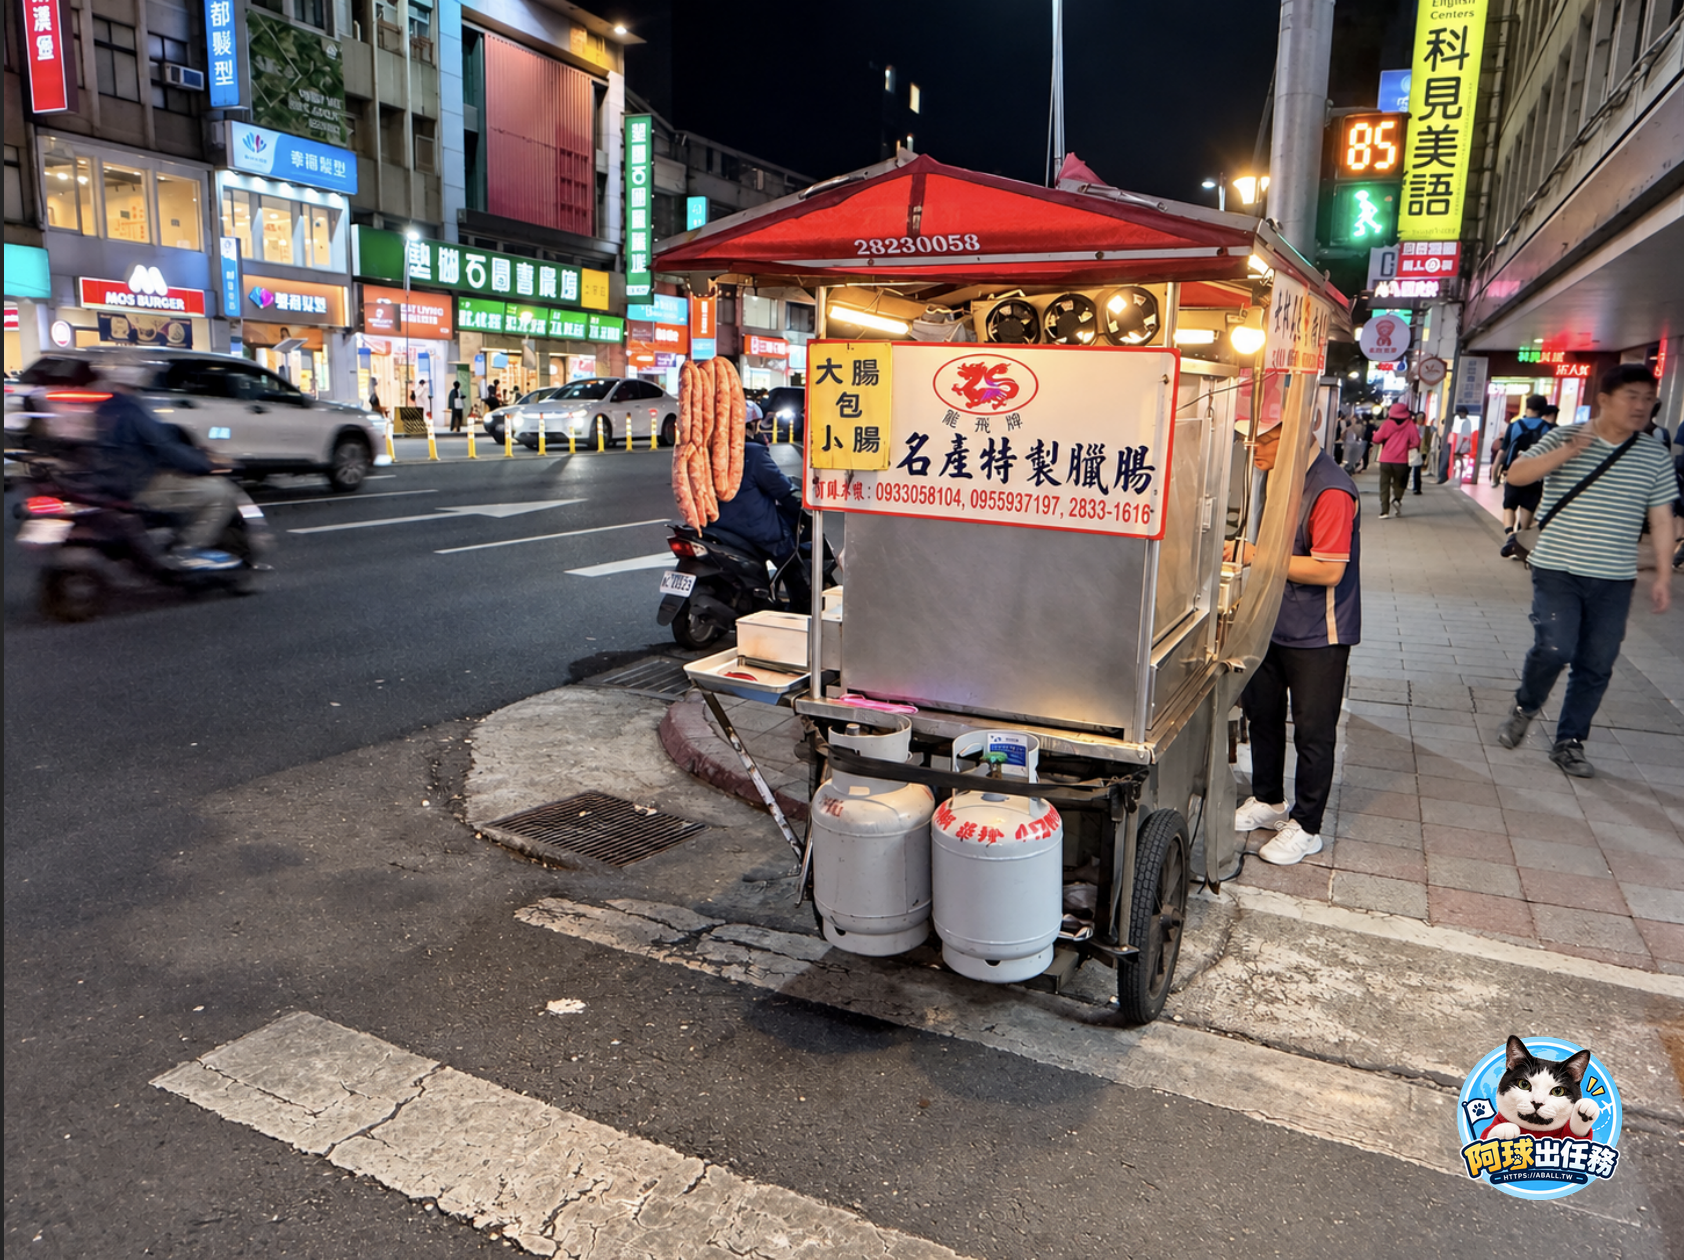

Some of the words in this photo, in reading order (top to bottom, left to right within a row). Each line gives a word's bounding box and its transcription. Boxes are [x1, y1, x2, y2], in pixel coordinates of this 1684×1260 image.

[1430, 10, 1475, 20] Centers
[32, 0, 54, 60] 漢堡
[1408, 25, 1470, 217] 科見美語
[1347, 121, 1398, 170] 85
[854, 234, 980, 255] 28230058
[105, 291, 135, 306] MOS
[137, 294, 185, 310] BURGER
[815, 357, 880, 387] 大腸
[835, 391, 863, 418] 包
[821, 424, 881, 454] 小腸
[1068, 496, 1150, 525] 2833-1616
